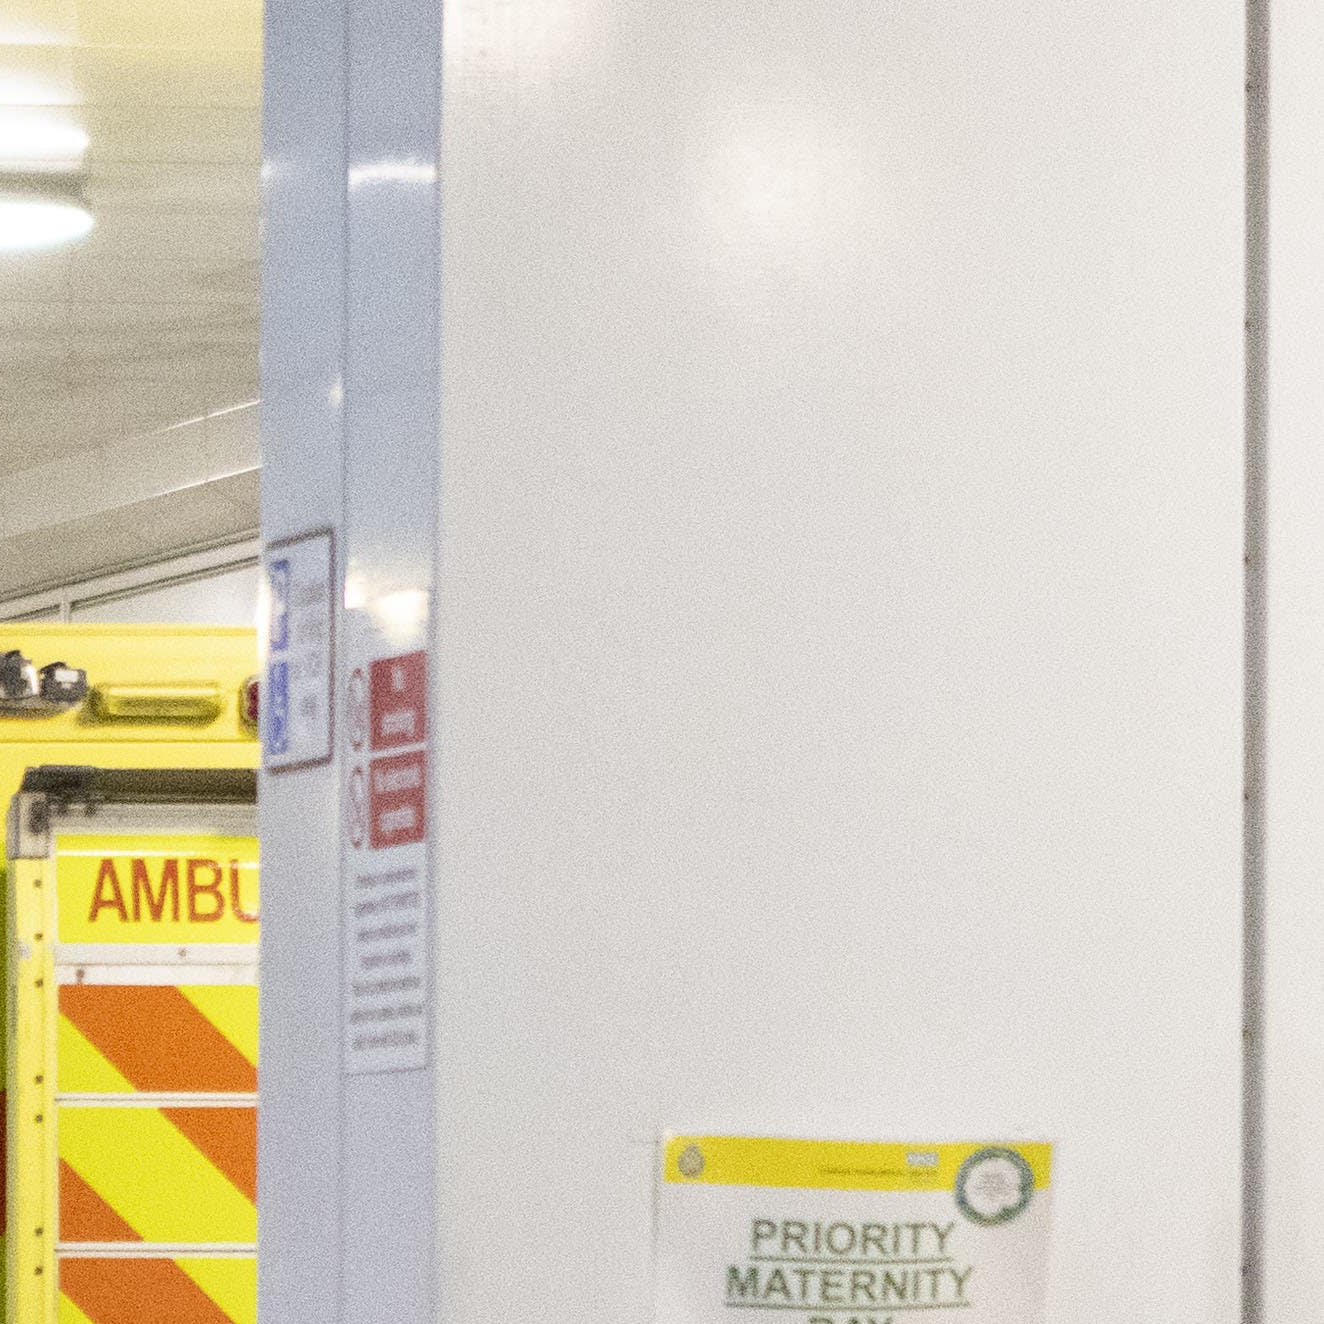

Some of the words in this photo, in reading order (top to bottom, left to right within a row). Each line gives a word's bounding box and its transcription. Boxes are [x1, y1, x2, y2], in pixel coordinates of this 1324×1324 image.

[88, 858, 260, 923] AMBU
[751, 1218, 955, 1256] PRIORITY
[725, 1265, 974, 1304] MATERNITY
